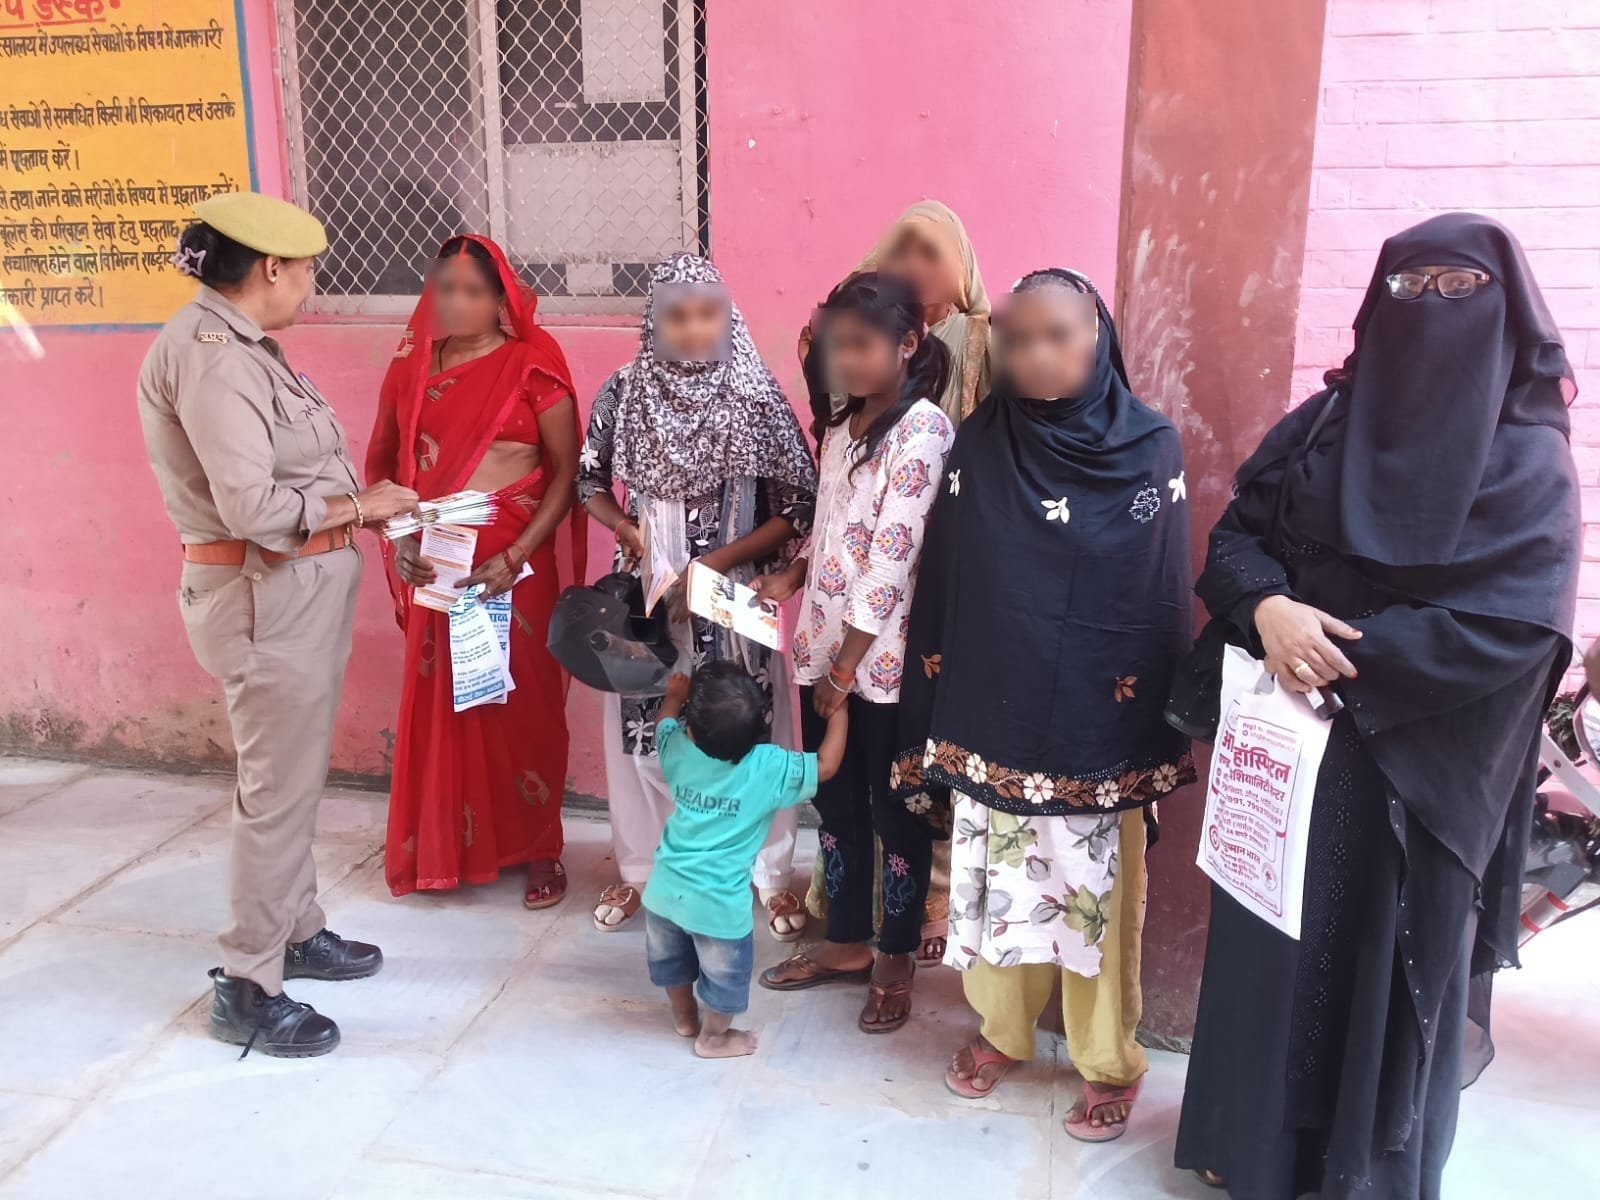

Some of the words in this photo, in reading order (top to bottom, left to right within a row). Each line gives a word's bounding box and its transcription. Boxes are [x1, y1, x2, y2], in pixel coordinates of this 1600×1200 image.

[0, 35, 37, 57] सालय
[138, 97, 185, 126] शिकायत
[186, 98, 203, 122] एवं
[205, 92, 236, 121] उसके
[10, 190, 34, 211] तथा
[35, 182, 60, 208] जाने
[61, 182, 83, 208] वाले
[127, 178, 156, 206] विषय
[0, 216, 28, 251] बूलेंस
[30, 217, 48, 240] की
[91, 214, 116, 241] सेवा
[117, 213, 140, 245] हेतु
[48, 245, 71, 275] होने
[72, 245, 99, 275] वाले
[0, 278, 37, 308] नकारी
[40, 286, 72, 311] प्राप्त
[675, 784, 742, 811] LEADER
